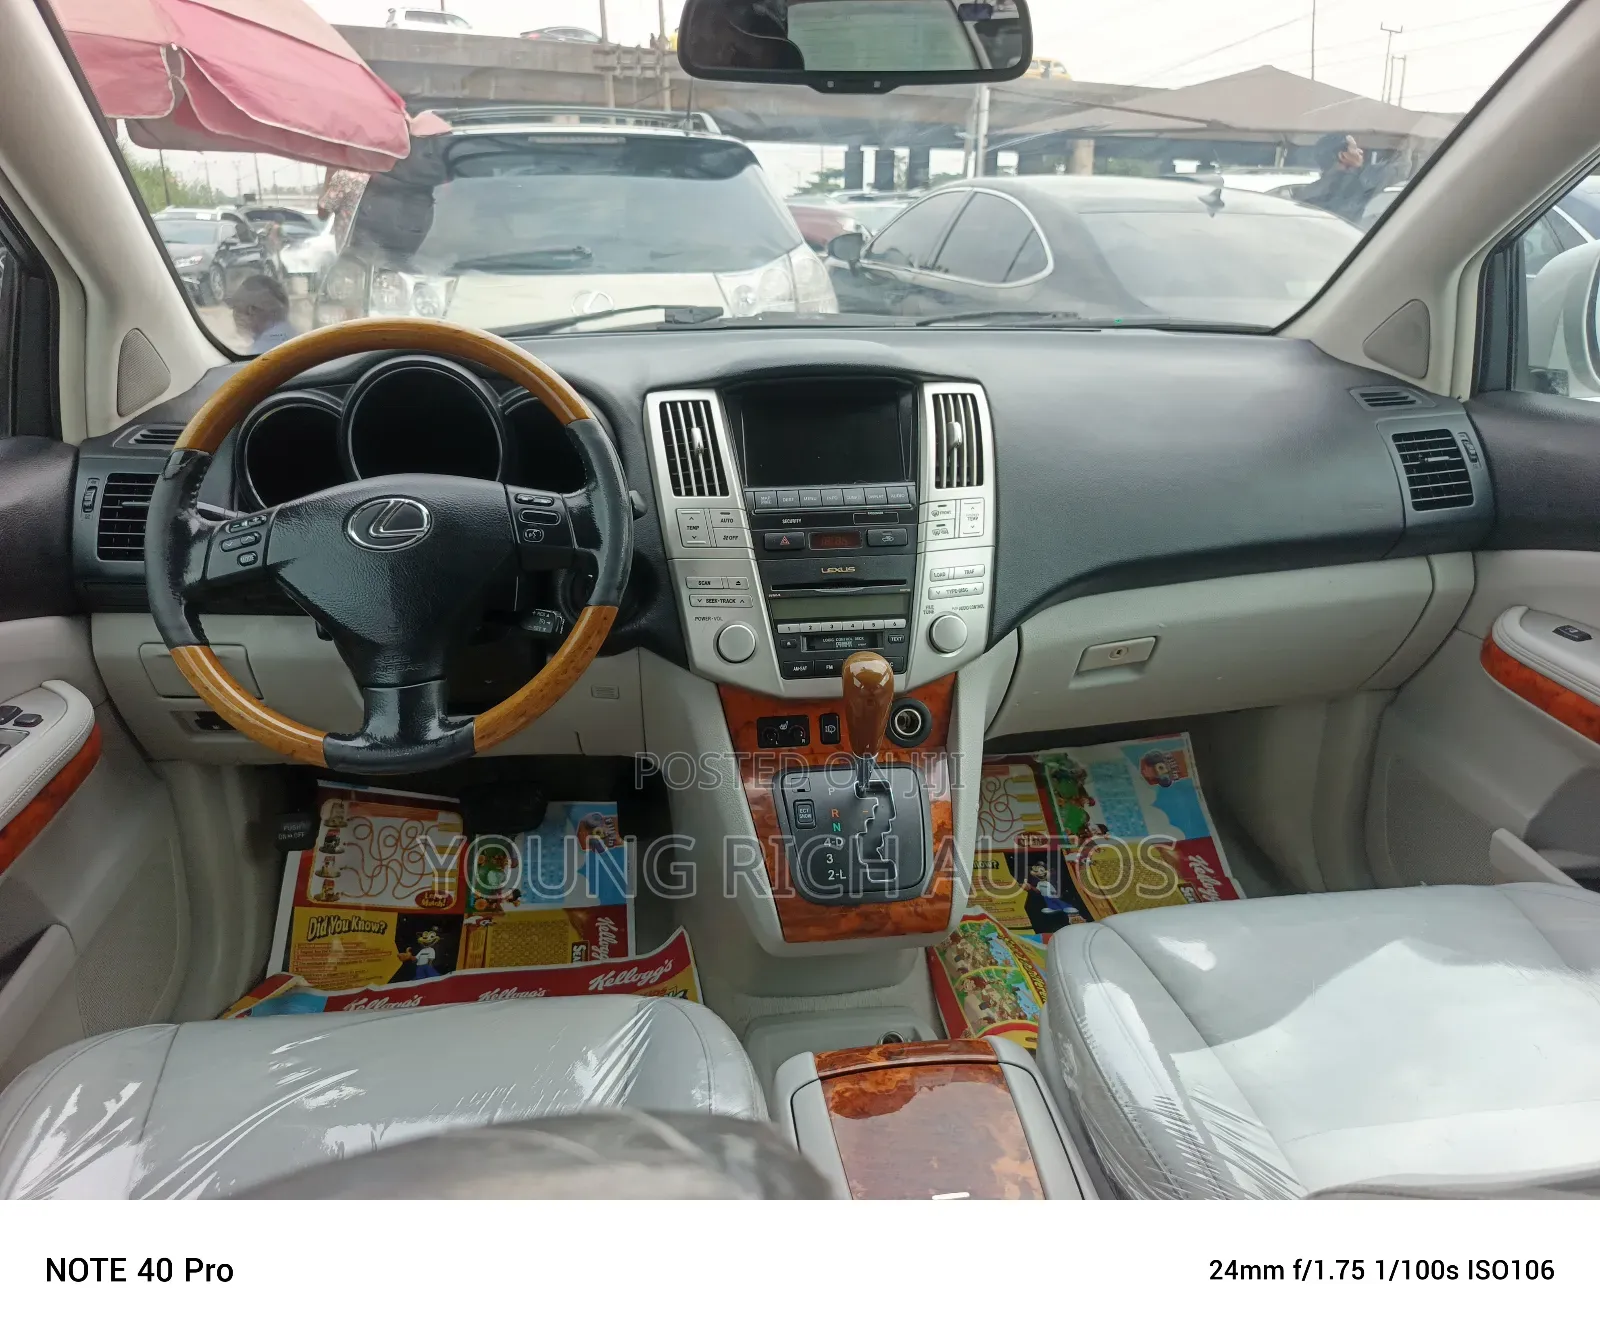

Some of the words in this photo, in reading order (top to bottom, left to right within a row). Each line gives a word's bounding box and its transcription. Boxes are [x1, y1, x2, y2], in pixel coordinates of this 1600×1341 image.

[828, 788, 836, 796] P
[832, 808, 840, 818] R
[832, 822, 841, 832] N
[826, 854, 834, 864] 3
[828, 869, 846, 880] 2-L
[307, 915, 329, 942] Did
[328, 914, 350, 934] You
[350, 914, 388, 935] Know?
[588, 959, 673, 990] Kellogg's
